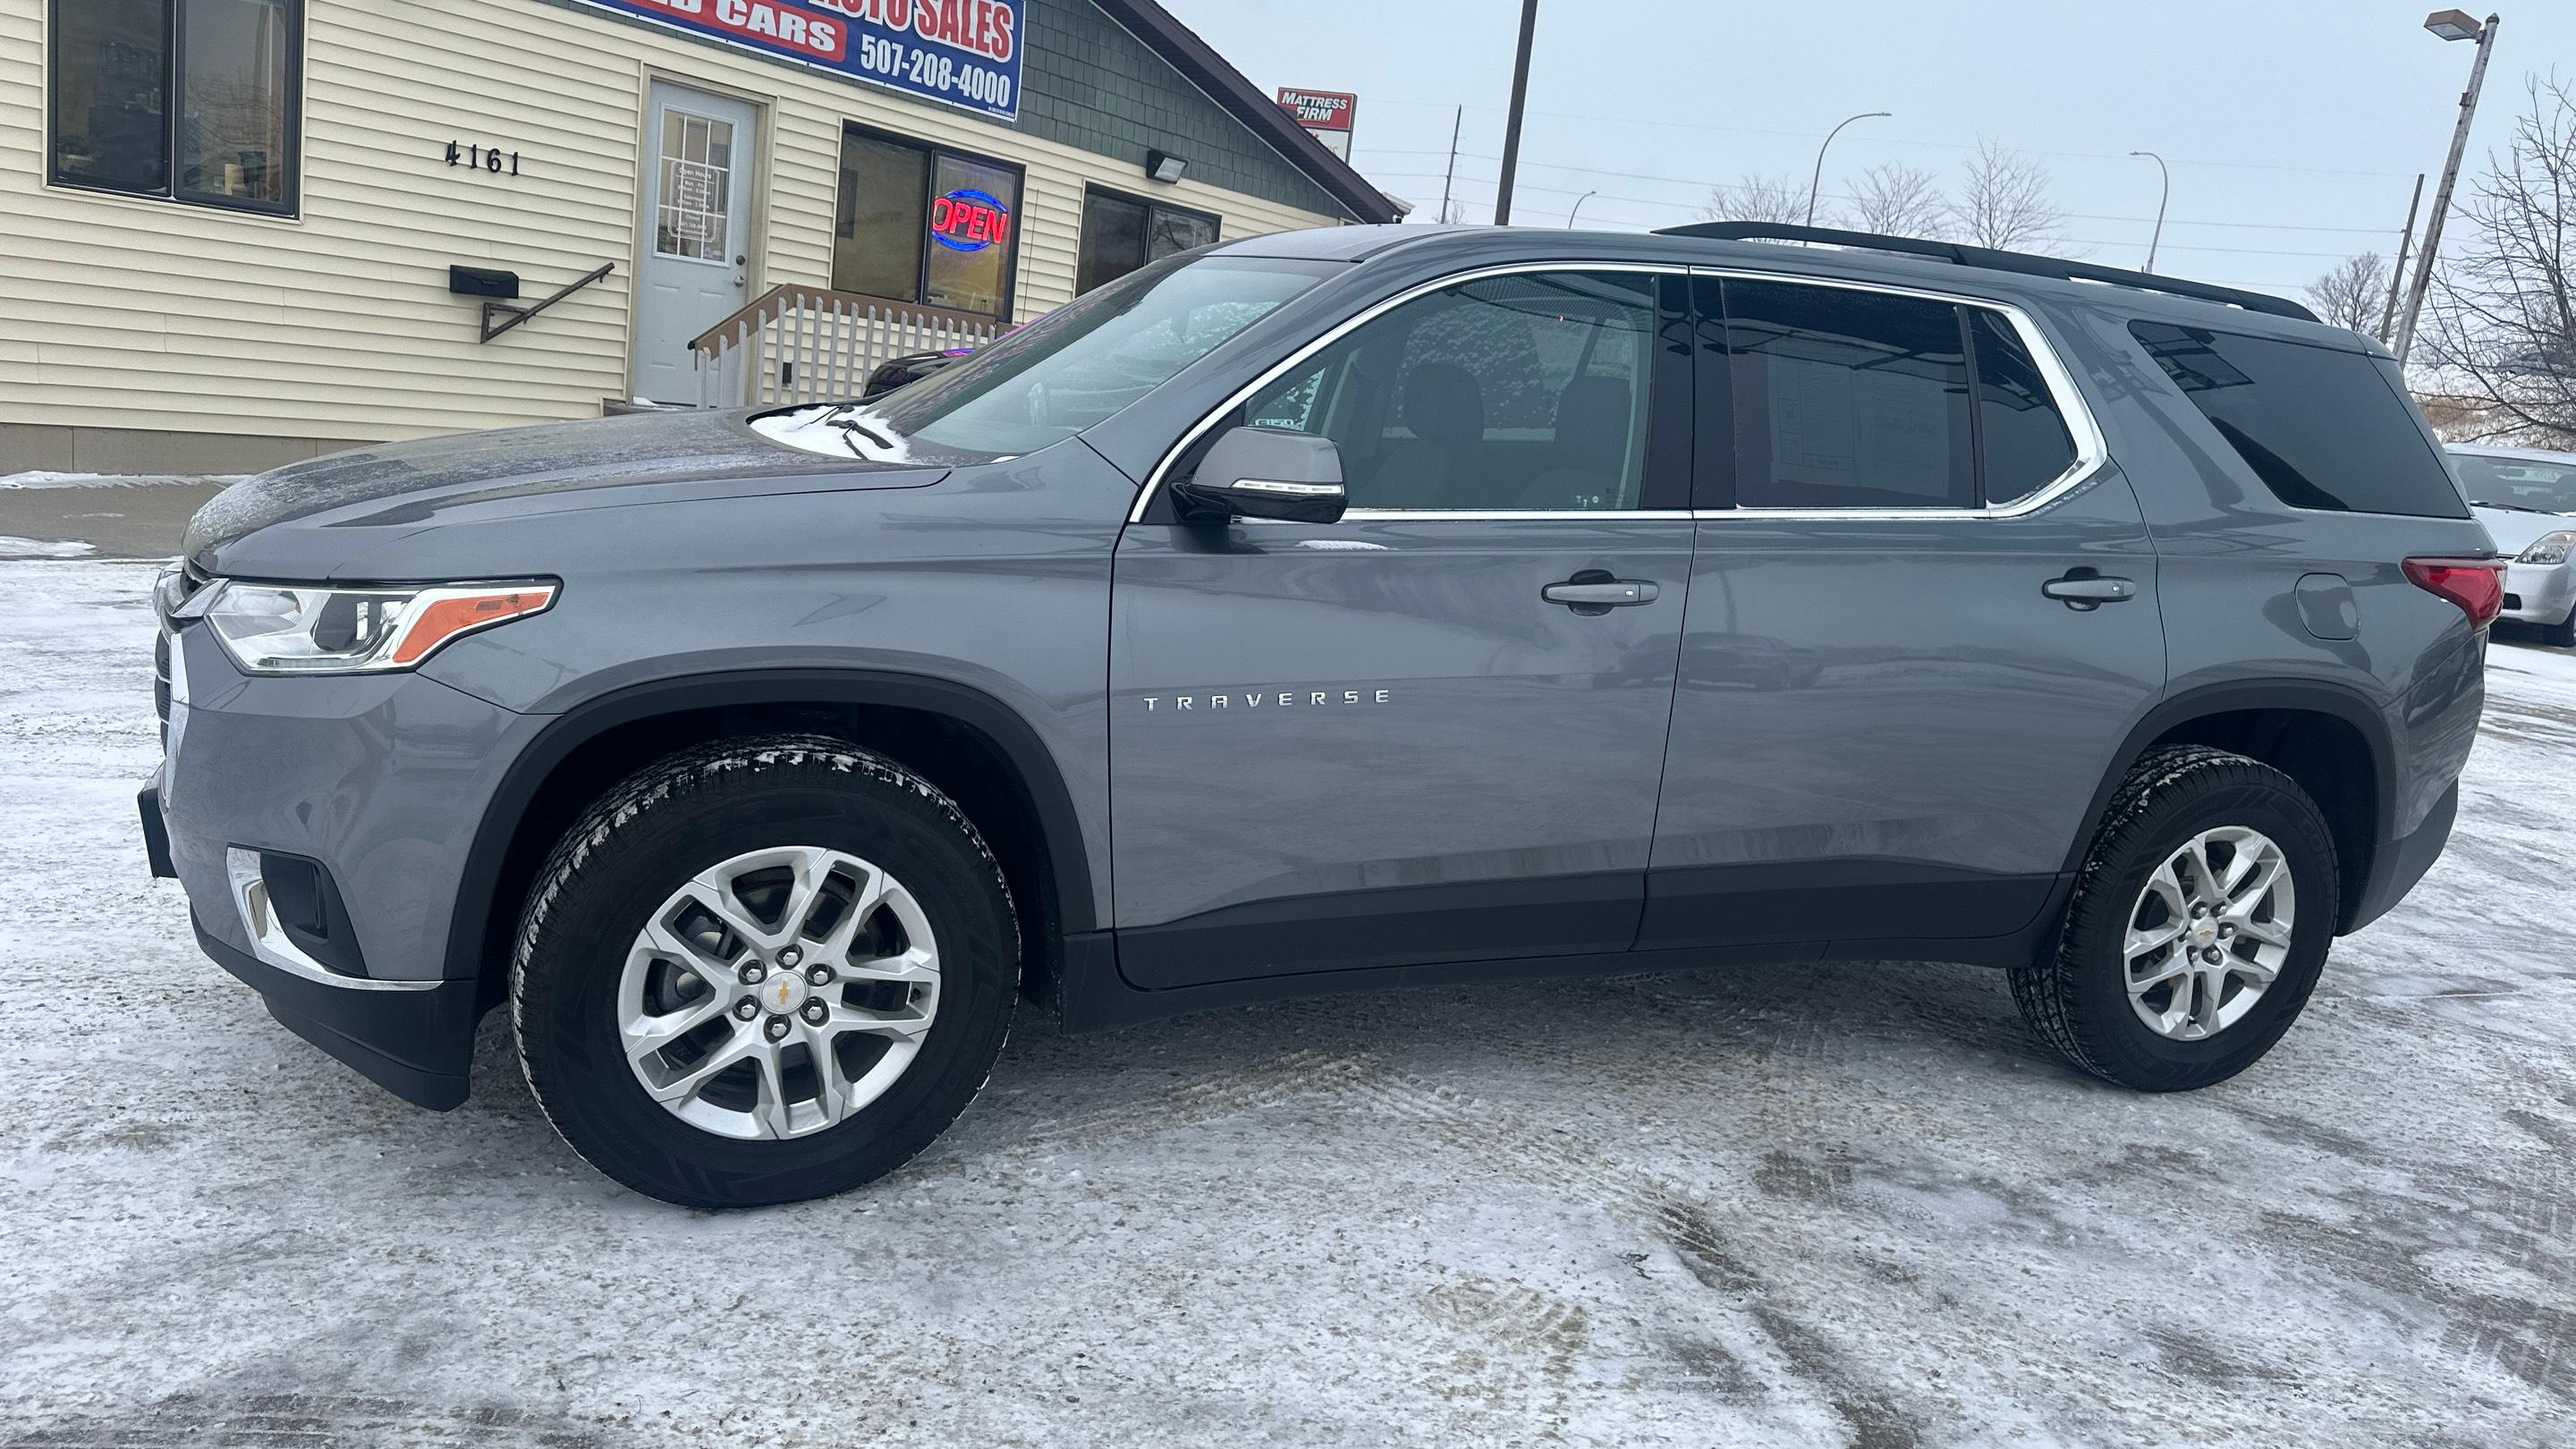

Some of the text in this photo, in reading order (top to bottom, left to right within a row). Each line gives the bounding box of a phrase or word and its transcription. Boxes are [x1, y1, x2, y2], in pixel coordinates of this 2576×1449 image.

[716, 0, 835, 52] CARS
[914, 0, 1013, 62] SALES
[860, 33, 1011, 107] 507-208-4000
[1281, 91, 1348, 110] MATTRESS
[1297, 106, 1333, 122] FIRM
[445, 140, 519, 176] 4161
[695, 170, 712, 180] Hous
[933, 198, 1007, 244] OPEN
[1143, 690, 1389, 712] TRAVERSE
